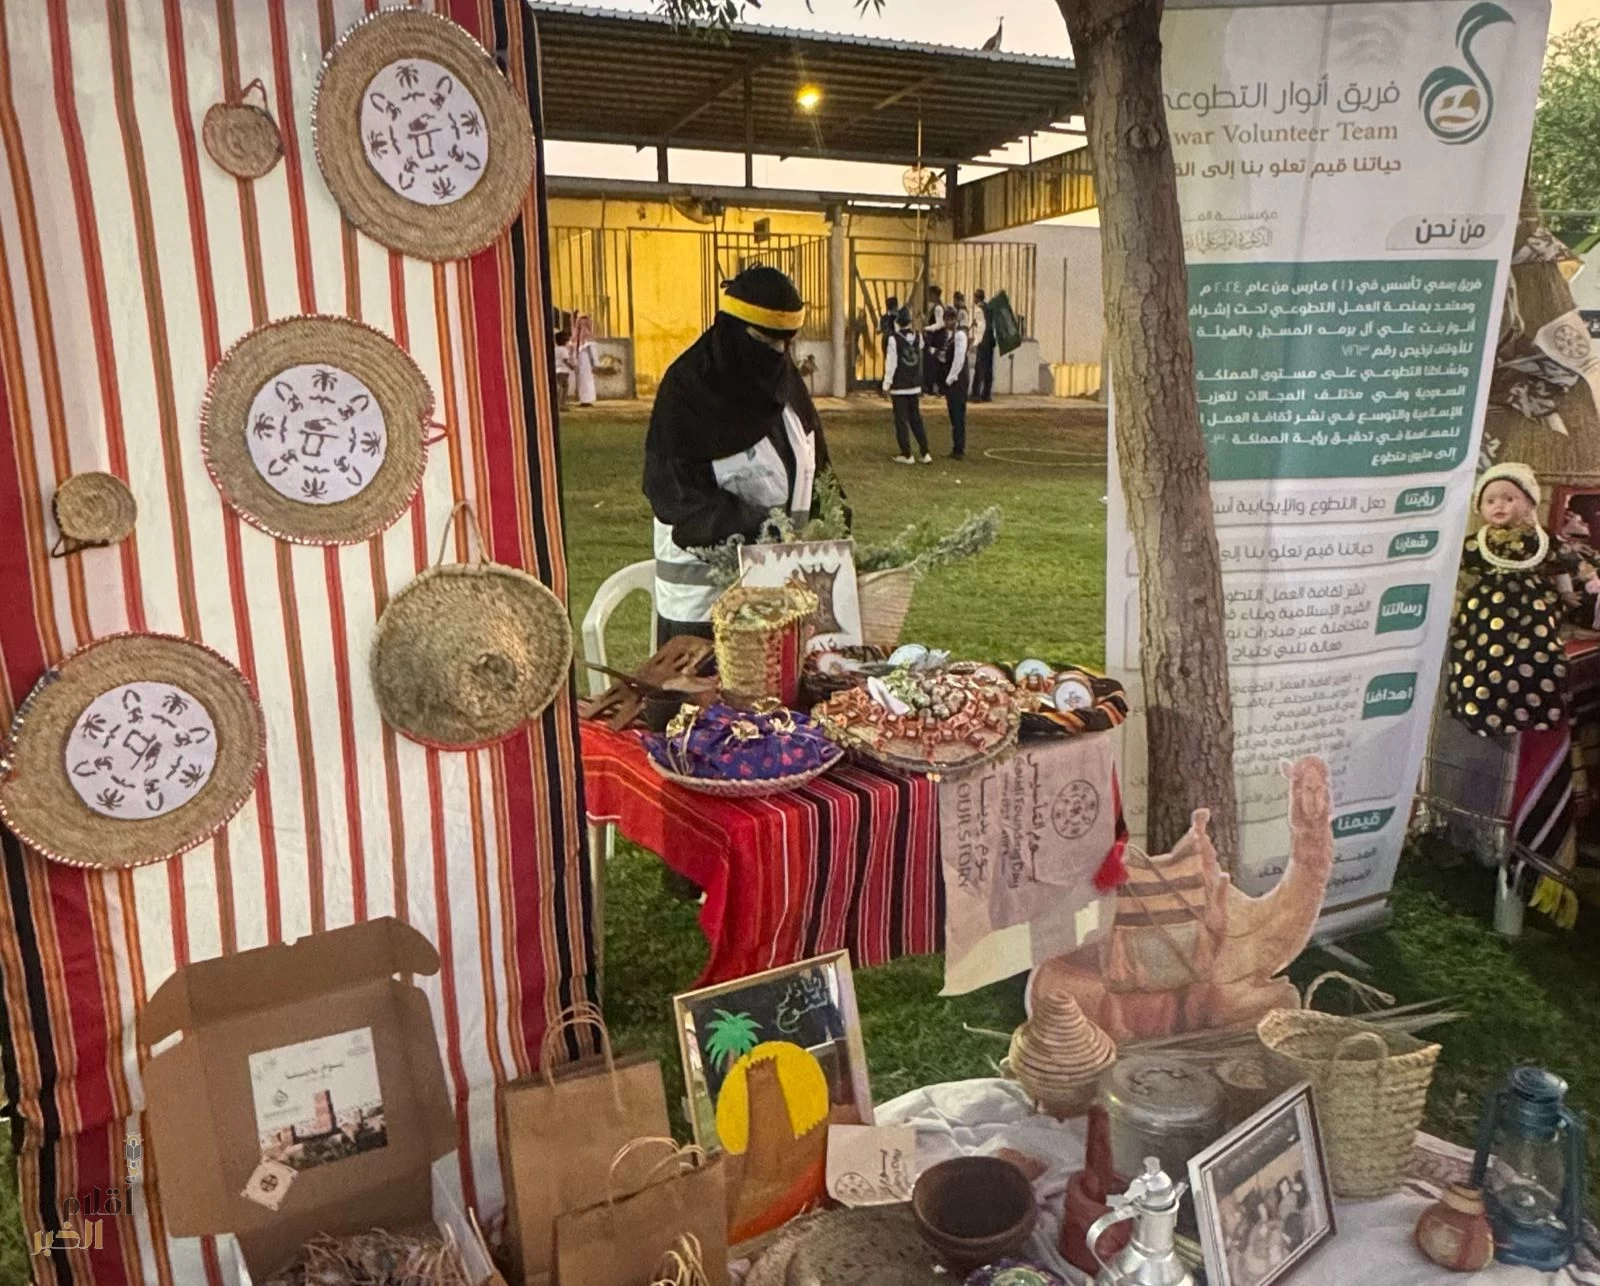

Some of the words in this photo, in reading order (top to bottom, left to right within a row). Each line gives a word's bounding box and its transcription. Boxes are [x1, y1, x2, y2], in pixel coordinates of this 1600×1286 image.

[1273, 74, 1328, 114] أنوار
[1337, 81, 1400, 112] فريق
[1221, 121, 1329, 144] Volunteer
[1336, 121, 1398, 141] Team
[1202, 160, 1235, 178] إلى
[1241, 160, 1263, 175] بنا
[1270, 159, 1305, 177] تعلو
[1310, 158, 1347, 178] قيم
[1353, 156, 1401, 175] حياتنا
[1416, 219, 1456, 244] نحن
[1461, 223, 1485, 244] من
[1245, 280, 1269, 296] عام
[1272, 282, 1289, 295] من
[1291, 280, 1328, 295] مارس
[1356, 279, 1378, 295] في
[1381, 275, 1422, 293] تأسس
[1457, 278, 1482, 293] فريق
[1233, 303, 1268, 315] تحت
[1269, 302, 1335, 318] التطوعي
[1338, 301, 1380, 316] العمل
[1383, 301, 1431, 314] بمنصة
[1257, 324, 1313, 339] المسجل
[1360, 320, 1375, 337] آل
[1377, 322, 1416, 338] علي
[1371, 343, 1398, 359] رقم
[1400, 343, 1433, 359] ترخيص
[1195, 368, 1259, 380] المملكة
[1261, 369, 1317, 382] مستوى
[1320, 367, 1356, 380] على
[1360, 366, 1422, 382] التطوعي
[1245, 389, 1305, 403] المجالات
[1314, 388, 1364, 400] مختلف
[1371, 388, 1409, 403] وفي
[1207, 412, 1250, 427] العمل
[1252, 409, 1292, 422] ثقافة
[1294, 409, 1325, 425] نشر
[1327, 410, 1355, 425] في
[1357, 409, 1410, 424] والتوسع
[1232, 432, 1289, 445] المملكة
[1292, 430, 1329, 446] رؤية
[1330, 431, 1374, 445] تحقيق
[1376, 429, 1403, 445] في
[1371, 451, 1406, 466] متطوع
[1434, 447, 1457, 461] إلى
[1236, 498, 1304, 516] والإيجابية
[1309, 496, 1357, 516] التطوع
[1245, 546, 1265, 559] بنا
[1268, 544, 1302, 562] تعلو
[1304, 544, 1334, 561] قيم
[1338, 542, 1373, 557] حياتنا
[1266, 587, 1304, 604] العمل
[1307, 583, 1343, 599] ثقافة
[1382, 602, 1423, 617] رسالتنا
[1244, 625, 1296, 641] مبادرات
[1337, 811, 1380, 830] قيمنا
